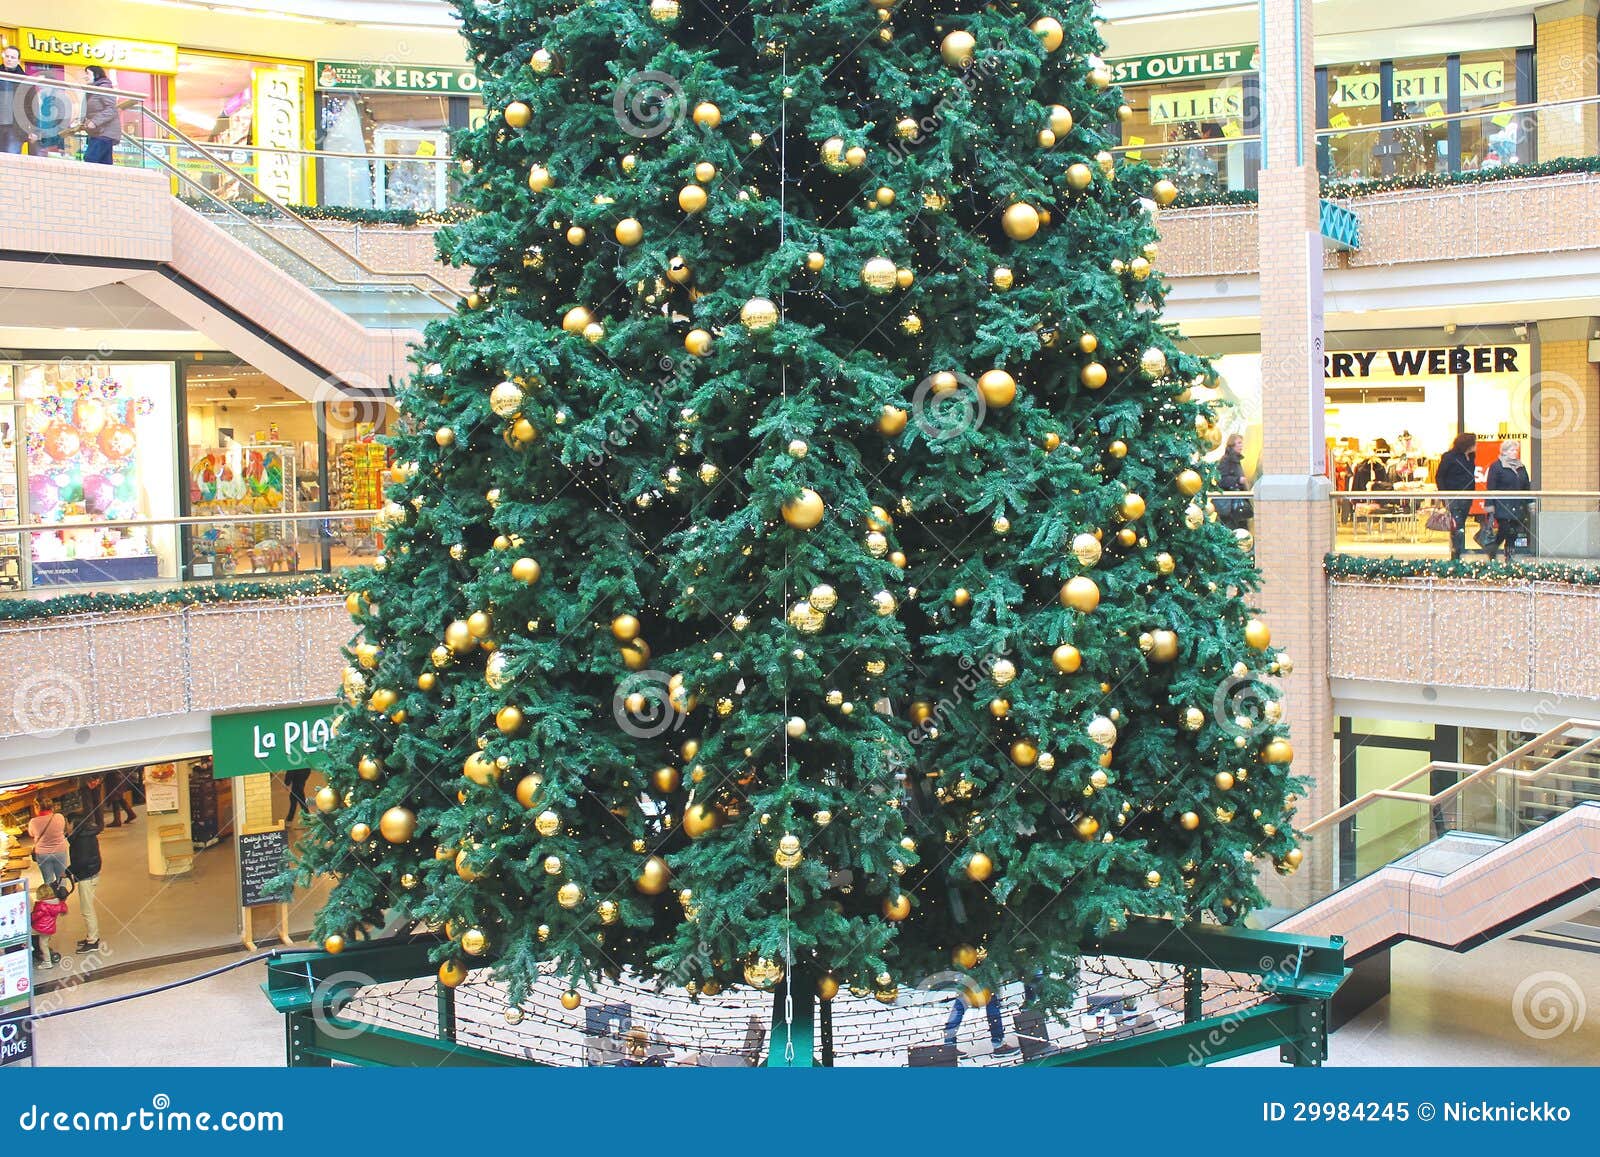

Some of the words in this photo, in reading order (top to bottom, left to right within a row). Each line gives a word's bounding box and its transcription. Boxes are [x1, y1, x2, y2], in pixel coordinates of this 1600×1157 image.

[1146, 51, 1241, 77] OUTLET
[374, 69, 453, 90] KERST
[1153, 94, 1240, 121] ALLES
[1387, 346, 1519, 376] WEBER
[253, 725, 276, 758] La
[1, 1039, 28, 1059] PLACE
